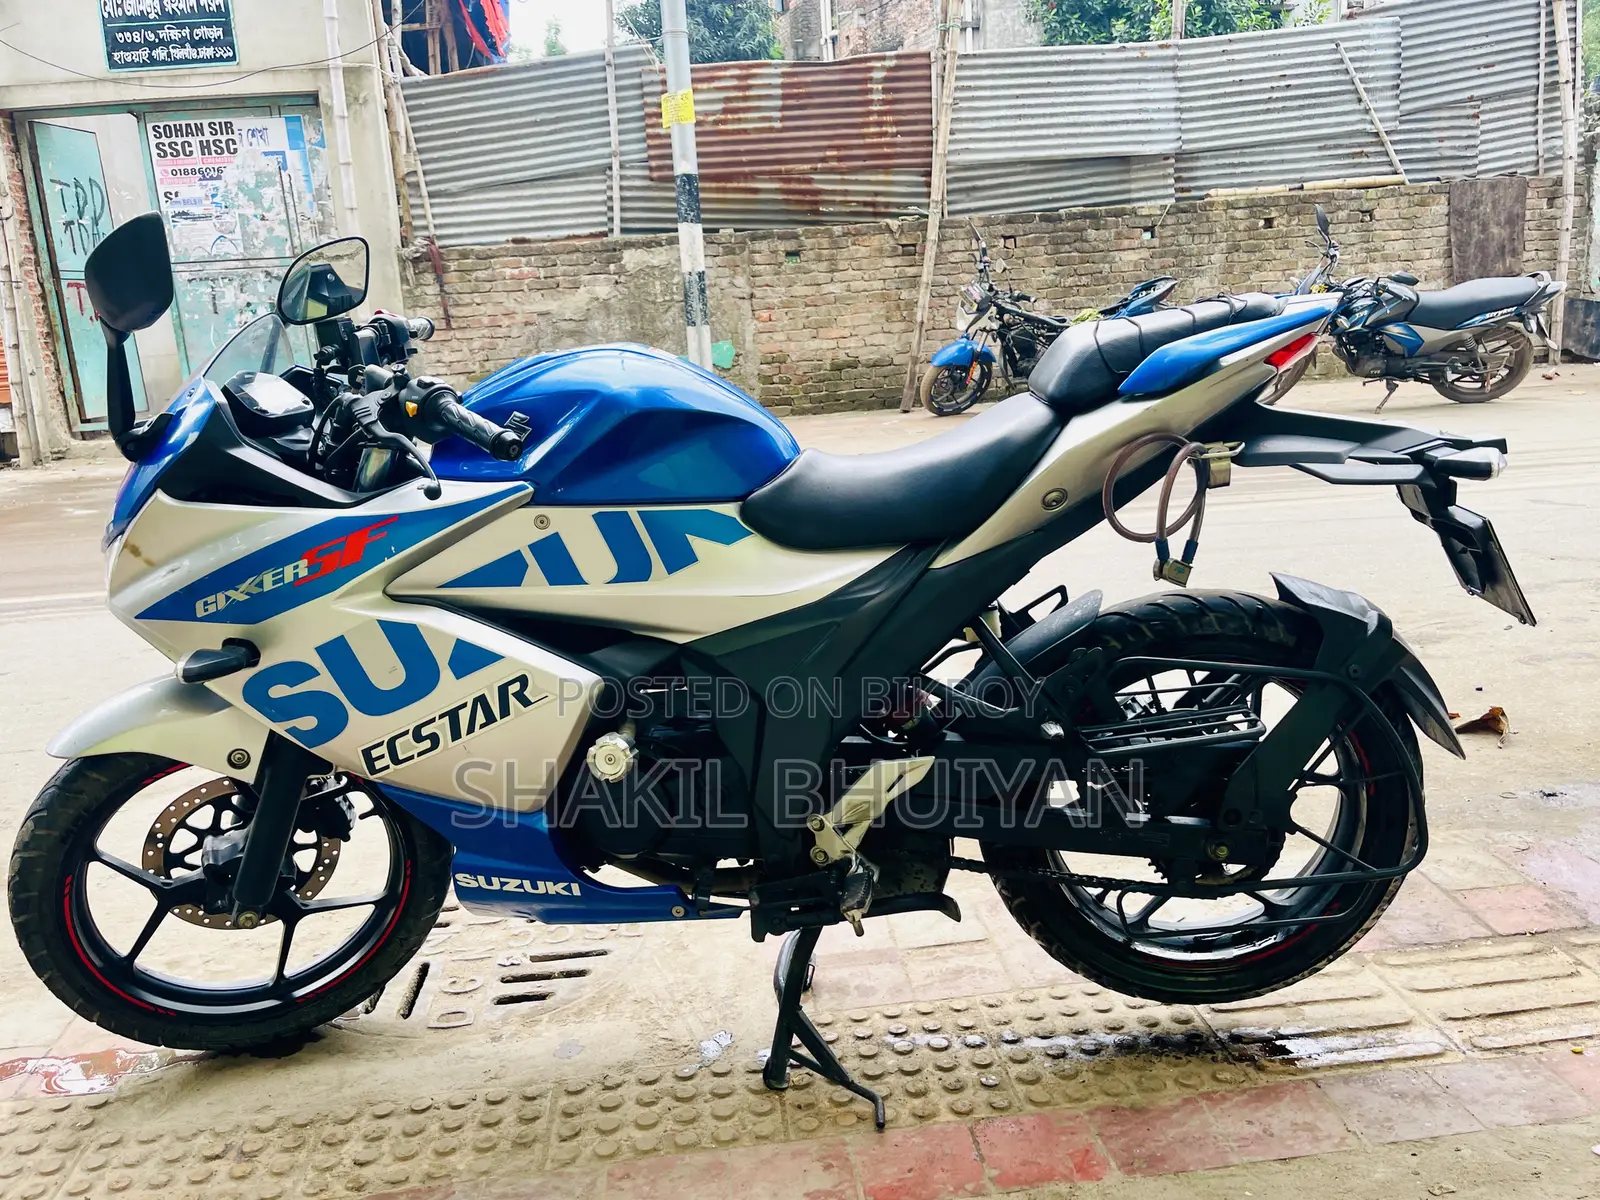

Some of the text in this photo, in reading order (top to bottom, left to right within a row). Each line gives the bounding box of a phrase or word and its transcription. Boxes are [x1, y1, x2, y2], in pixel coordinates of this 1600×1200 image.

[152, 121, 235, 140] SOHAN SIR
[155, 138, 238, 158] SSC HSC
[195, 515, 399, 618] GIXXER SF
[361, 673, 549, 777] ECSTAR
[454, 872, 582, 897] SUZUKI
